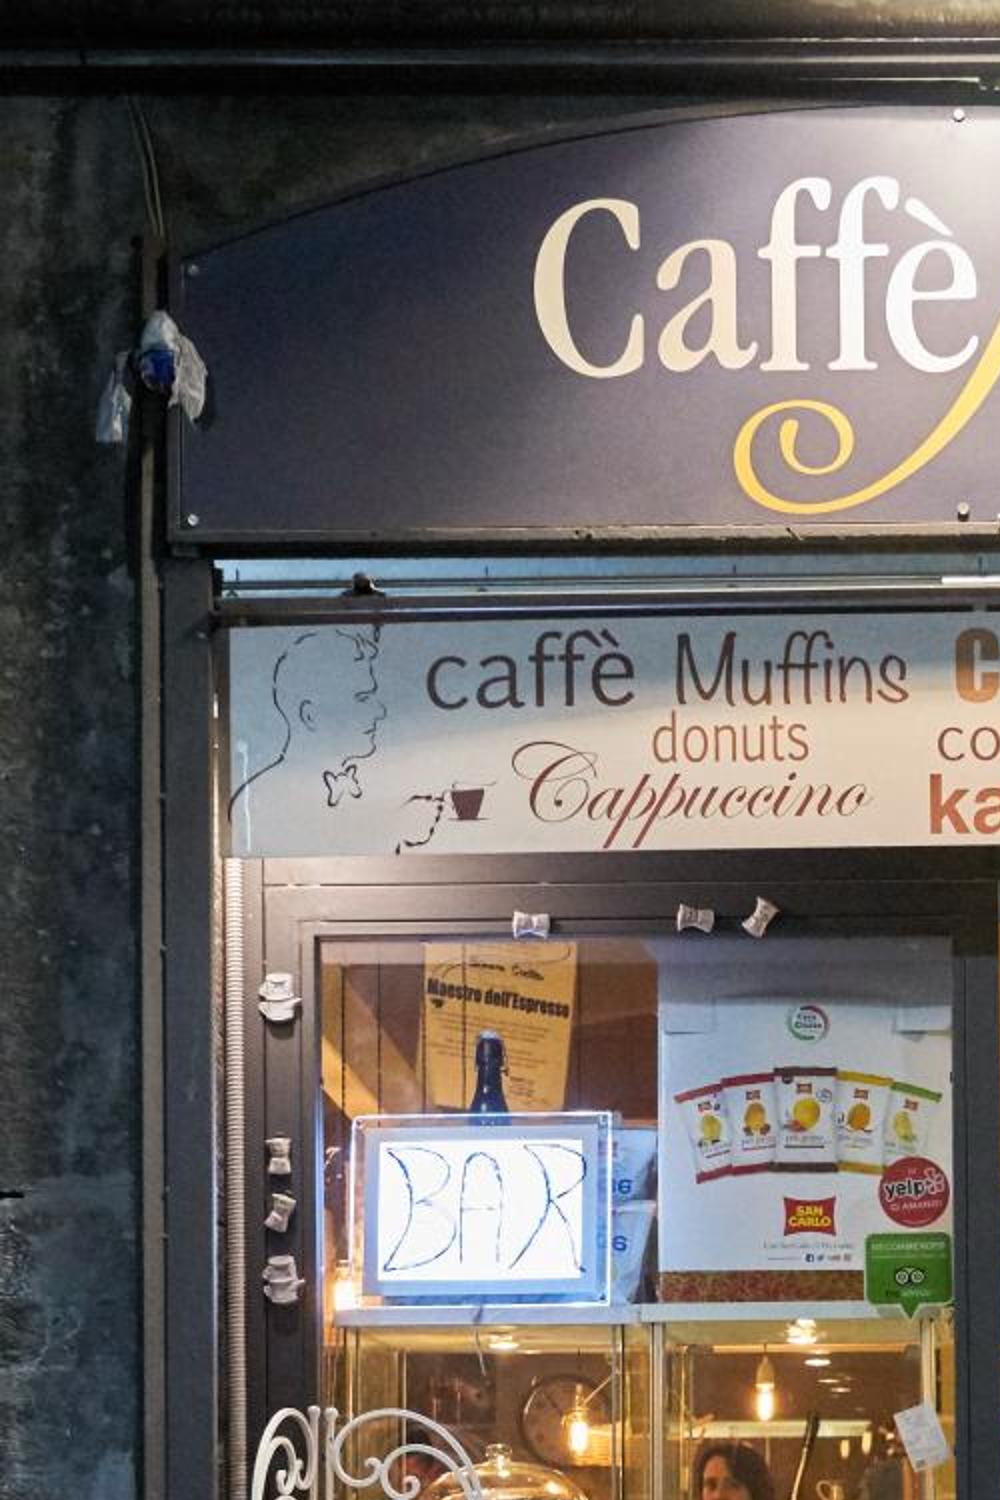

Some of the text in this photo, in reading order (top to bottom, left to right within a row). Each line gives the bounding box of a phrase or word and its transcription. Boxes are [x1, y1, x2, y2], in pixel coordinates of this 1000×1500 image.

[533, 175, 981, 378] Caffè
[426, 628, 637, 710] caffè
[675, 630, 911, 706] Muffins
[652, 711, 810, 764] donuts
[511, 740, 874, 849] Cappuccino
[427, 977, 482, 1003] Maestro
[383, 1142, 587, 1273] BAR
[796, 1205, 824, 1217] SAN
[884, 1179, 926, 1200] yelp
[788, 1215, 832, 1228] CARLO
